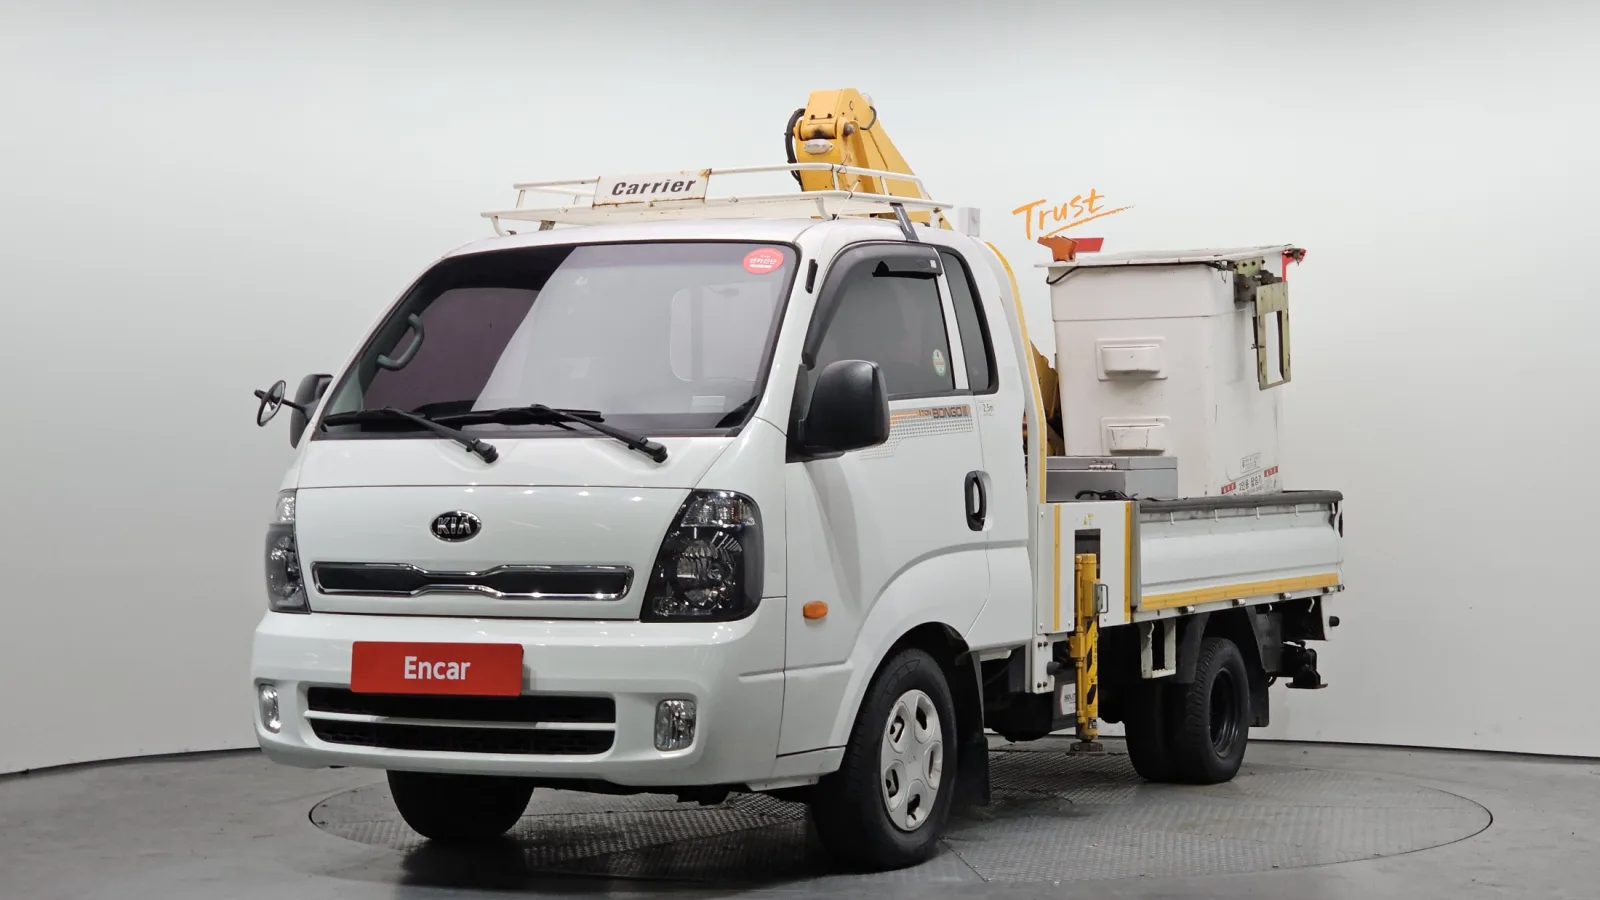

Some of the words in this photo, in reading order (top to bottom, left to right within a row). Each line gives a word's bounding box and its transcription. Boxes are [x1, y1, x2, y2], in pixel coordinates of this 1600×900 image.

[611, 179, 697, 196] Carrier
[1012, 188, 1105, 240] Trust
[437, 516, 472, 535] KIA
[404, 656, 471, 680] Encar
